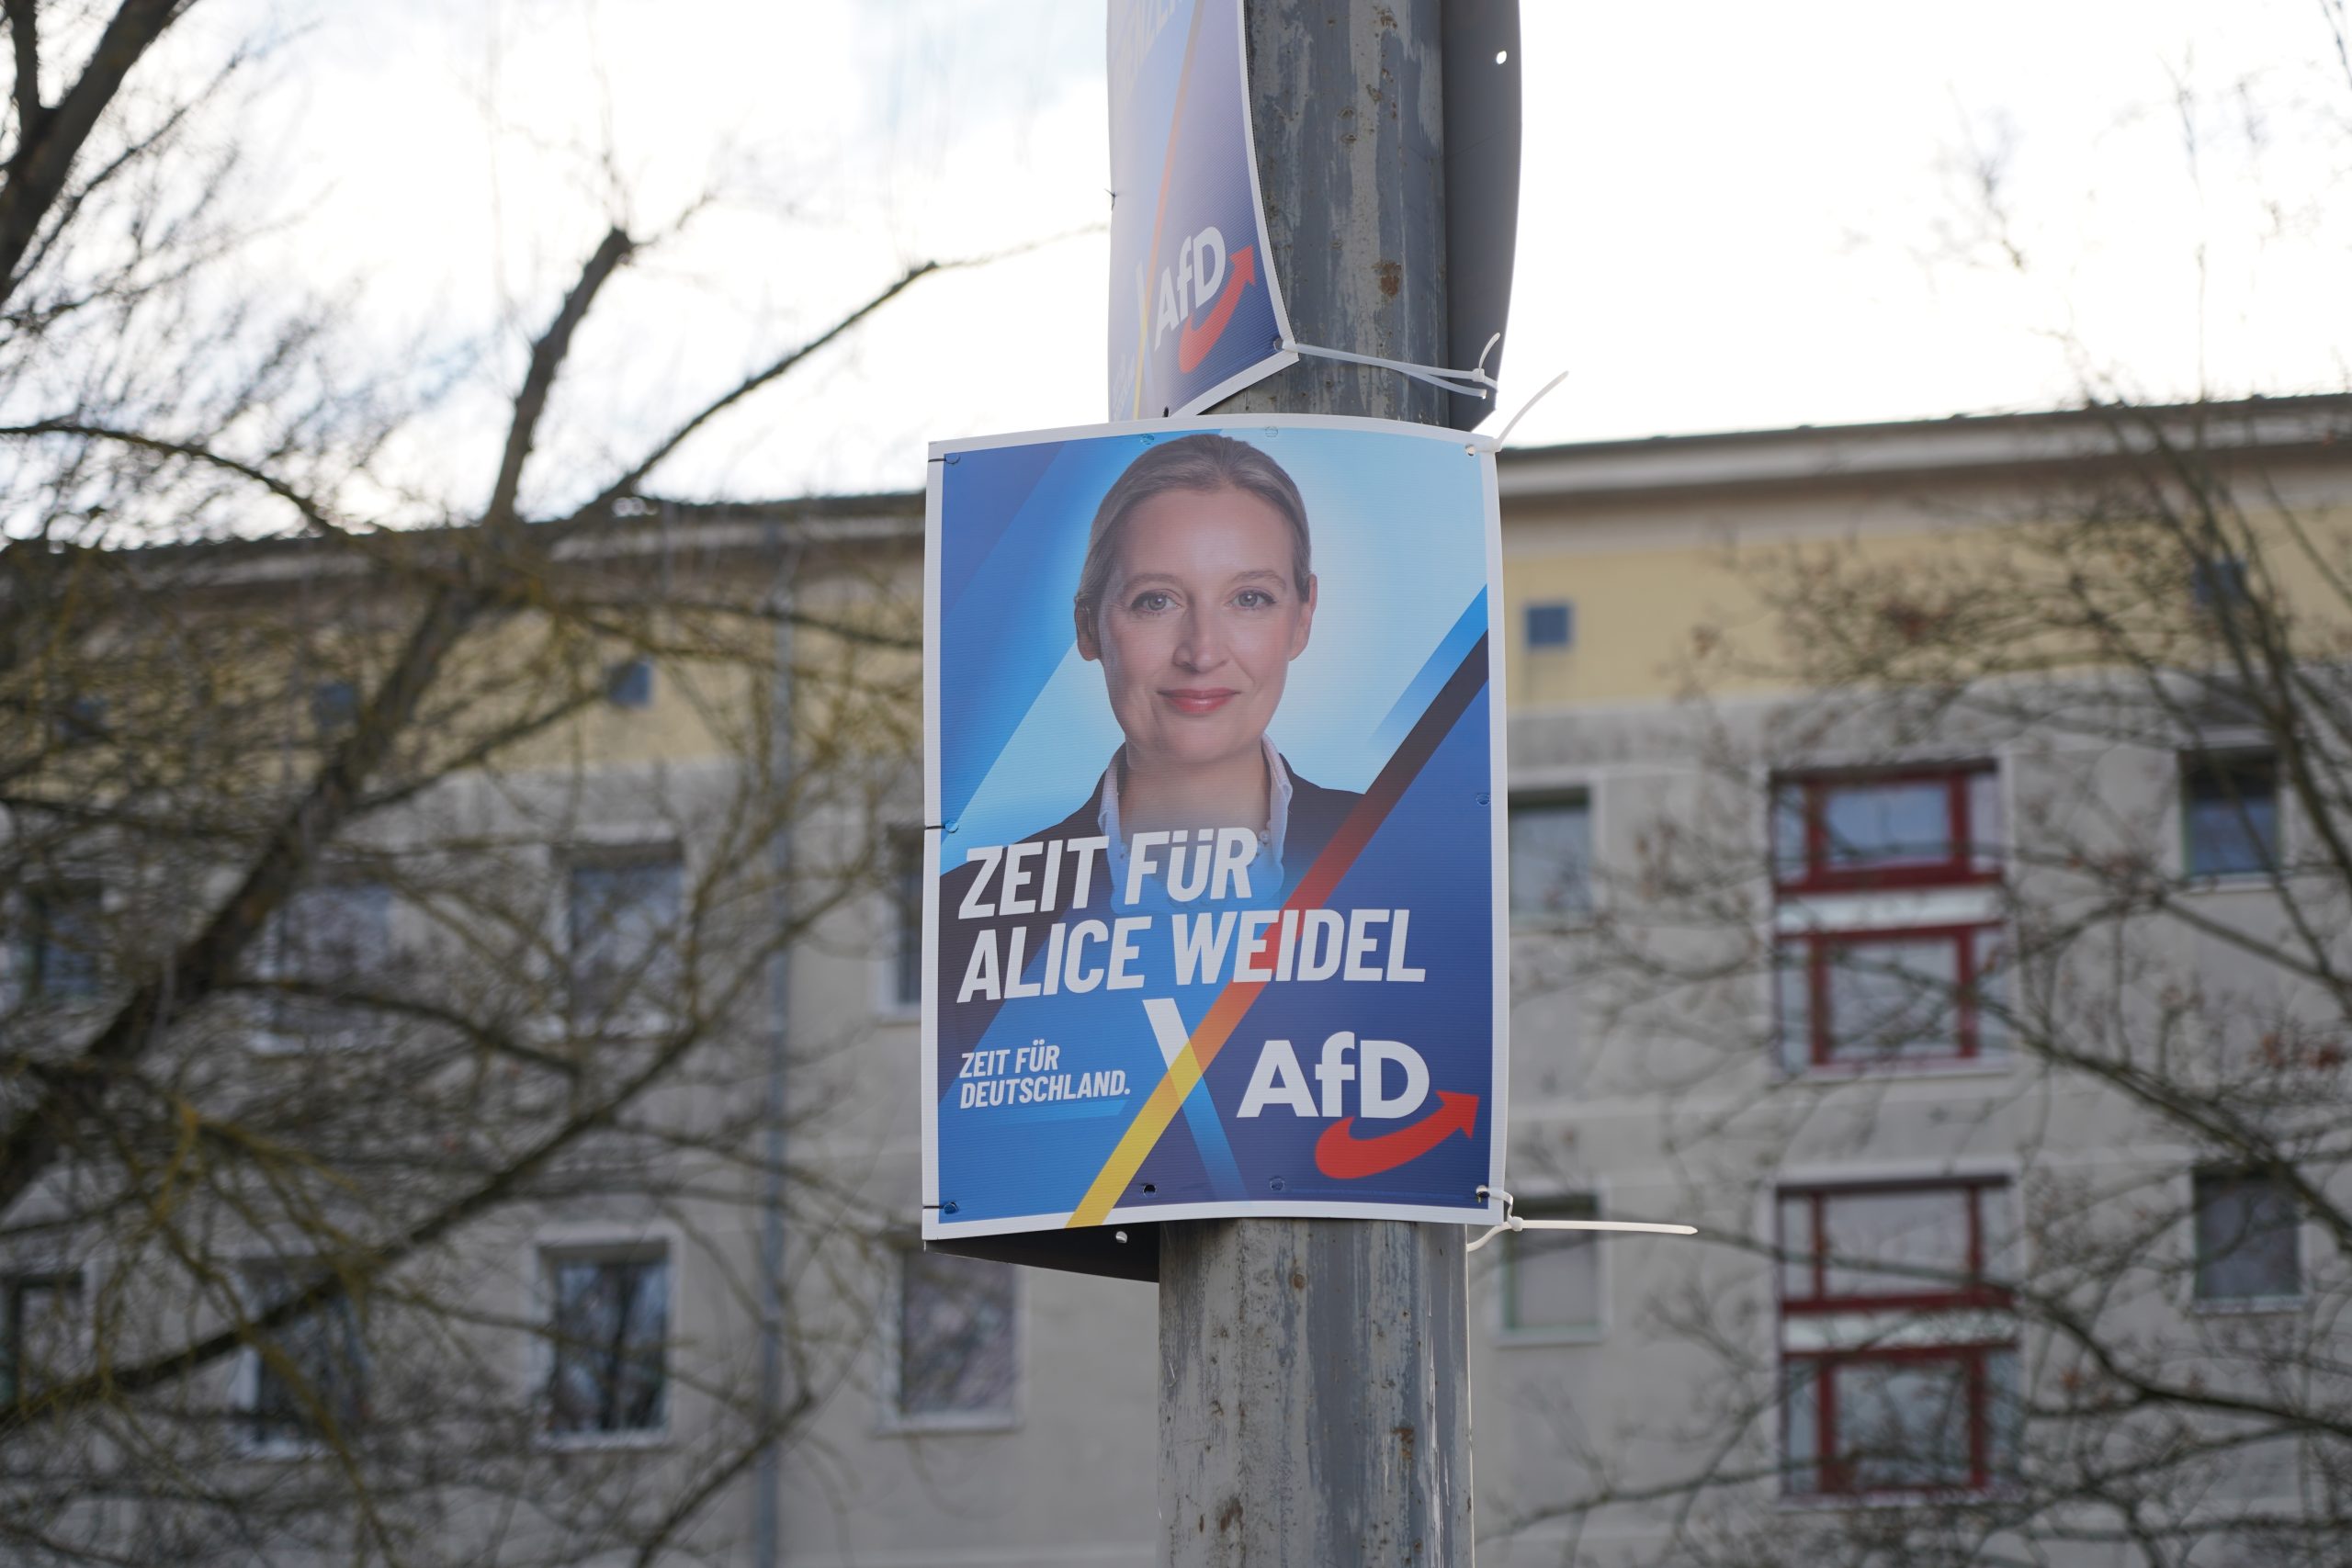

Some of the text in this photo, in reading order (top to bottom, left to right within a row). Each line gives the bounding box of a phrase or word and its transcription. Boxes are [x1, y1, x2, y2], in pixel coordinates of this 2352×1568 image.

[1154, 226, 1227, 352] AfD
[957, 827, 1259, 919] ZEIT FÜR
[956, 908, 1427, 1003] ALICE WEIDEL
[959, 1039, 1060, 1078] ZEIT FÜR
[959, 1069, 1131, 1110] DEUTSCHLAND.
[1236, 1031, 1430, 1119] AfD
